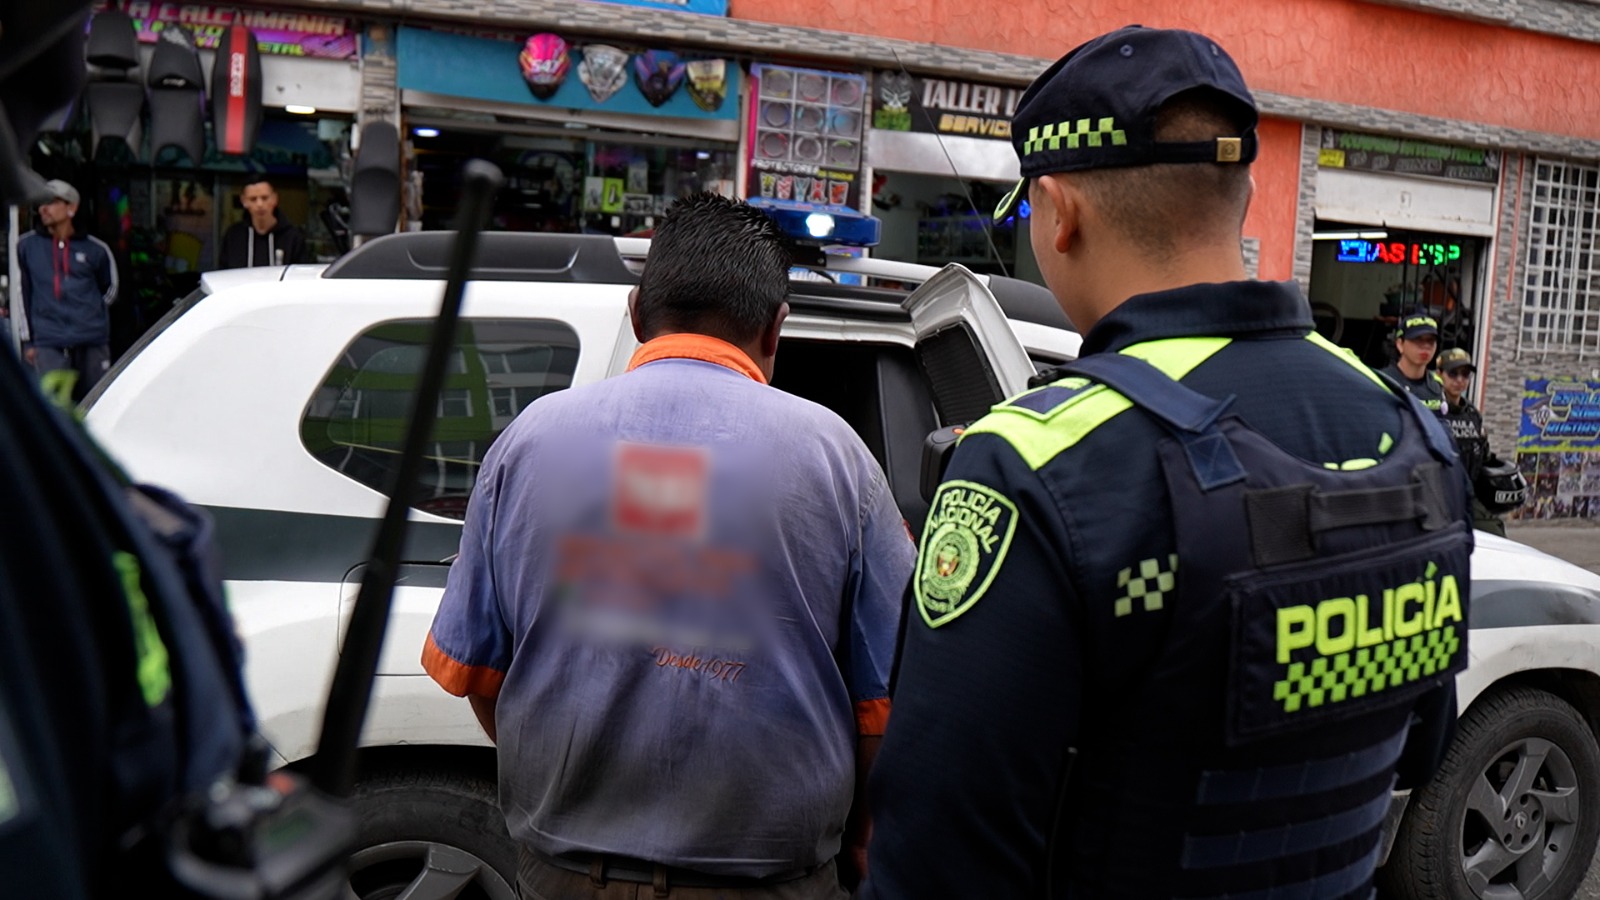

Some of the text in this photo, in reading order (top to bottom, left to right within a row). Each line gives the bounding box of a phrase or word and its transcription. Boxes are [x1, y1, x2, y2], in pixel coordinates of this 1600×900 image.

[921, 78, 1000, 115] TALLER
[930, 507, 1000, 554] NACIONAL
[1276, 561, 1463, 664] POLICÍA
[652, 648, 746, 682] Desde 1977
